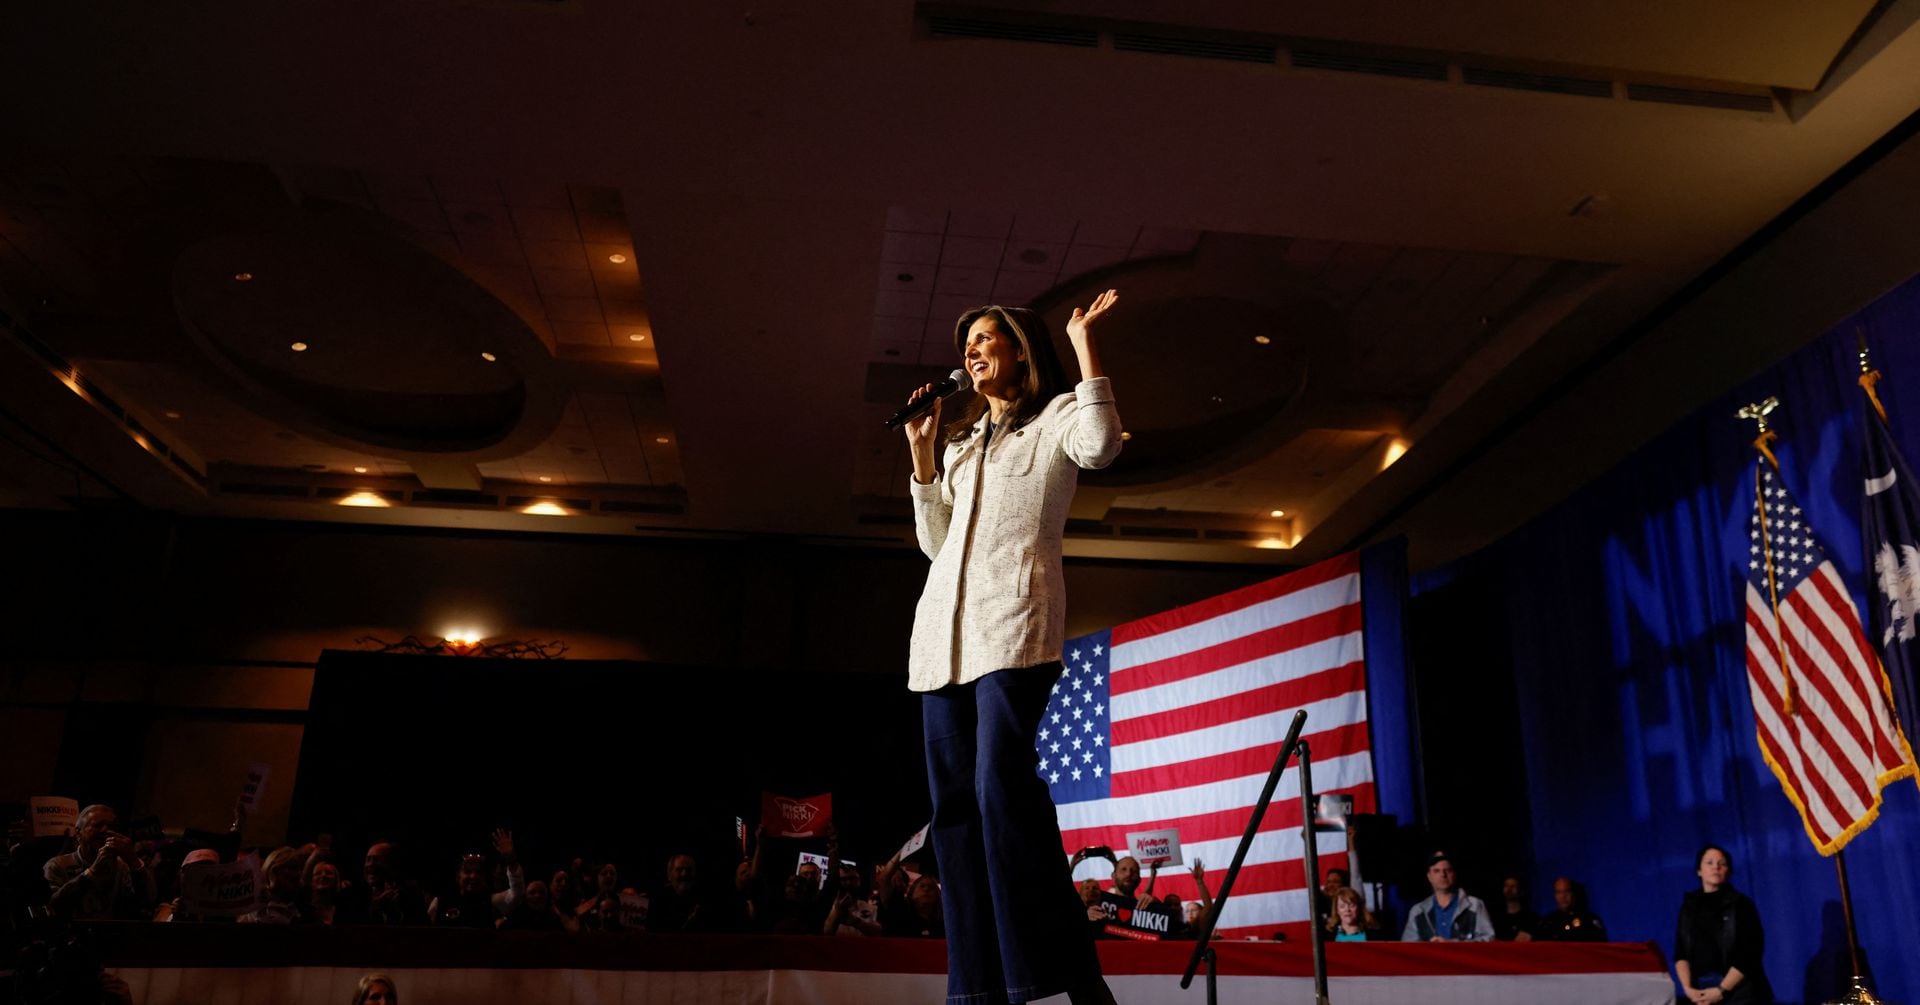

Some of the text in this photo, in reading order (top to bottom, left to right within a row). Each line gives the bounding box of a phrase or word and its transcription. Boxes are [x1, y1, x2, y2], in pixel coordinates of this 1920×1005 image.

[1137, 838, 1169, 851] Women
[1146, 846, 1170, 856] NIKKI
[1131, 909, 1169, 932] NIKKI
